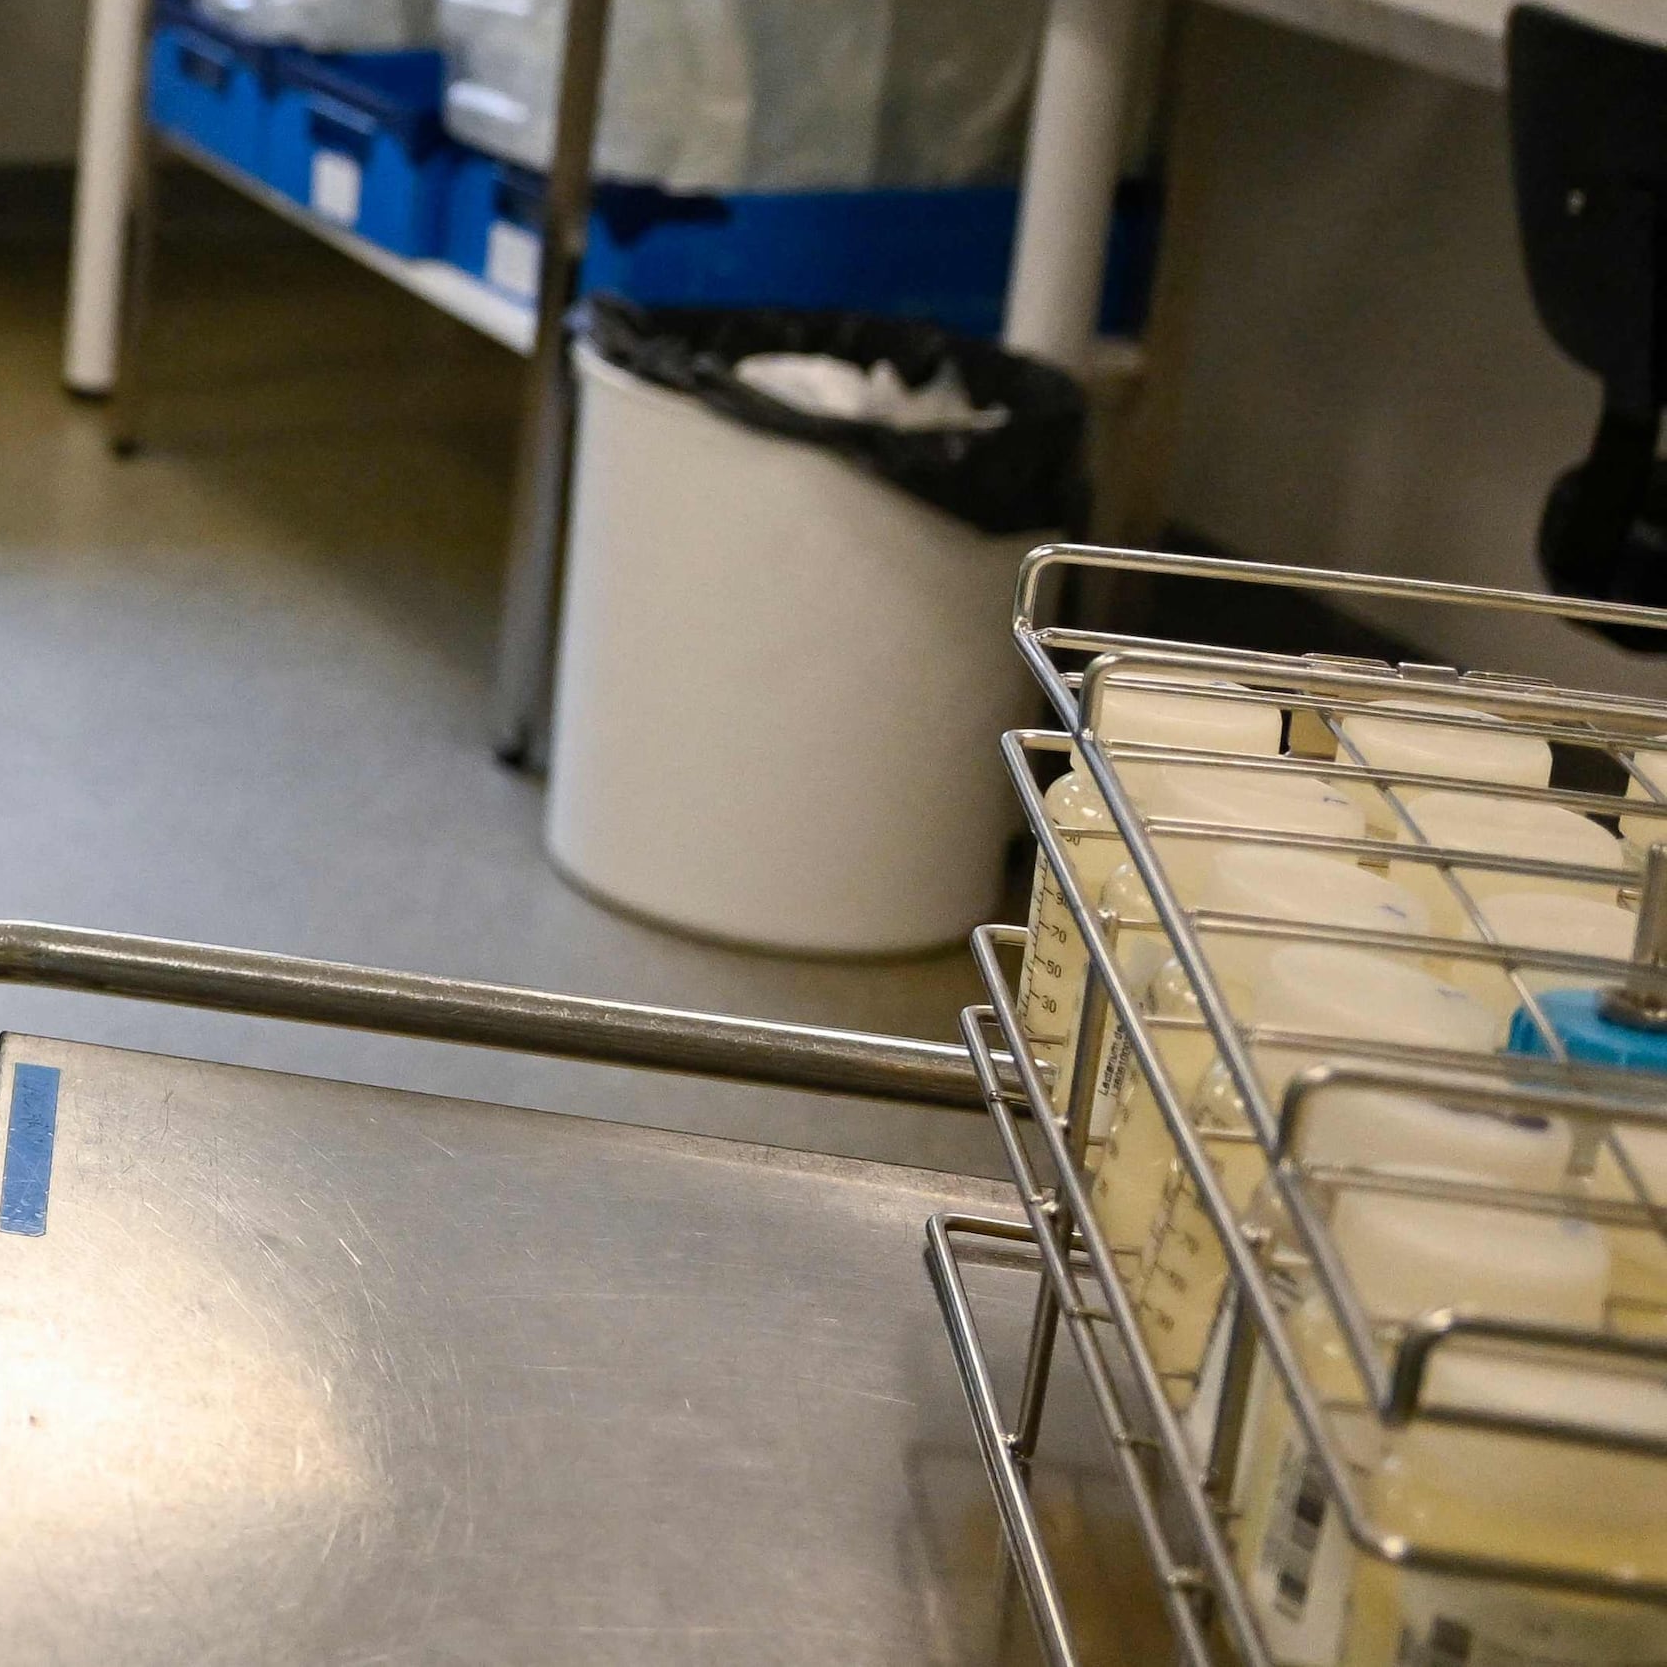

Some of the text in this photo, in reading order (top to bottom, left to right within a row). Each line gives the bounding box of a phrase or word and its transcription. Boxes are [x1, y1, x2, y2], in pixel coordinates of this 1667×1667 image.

[1047, 925, 1067, 944] 70
[1045, 961, 1062, 978] 50
[1042, 995, 1057, 1013] 30
